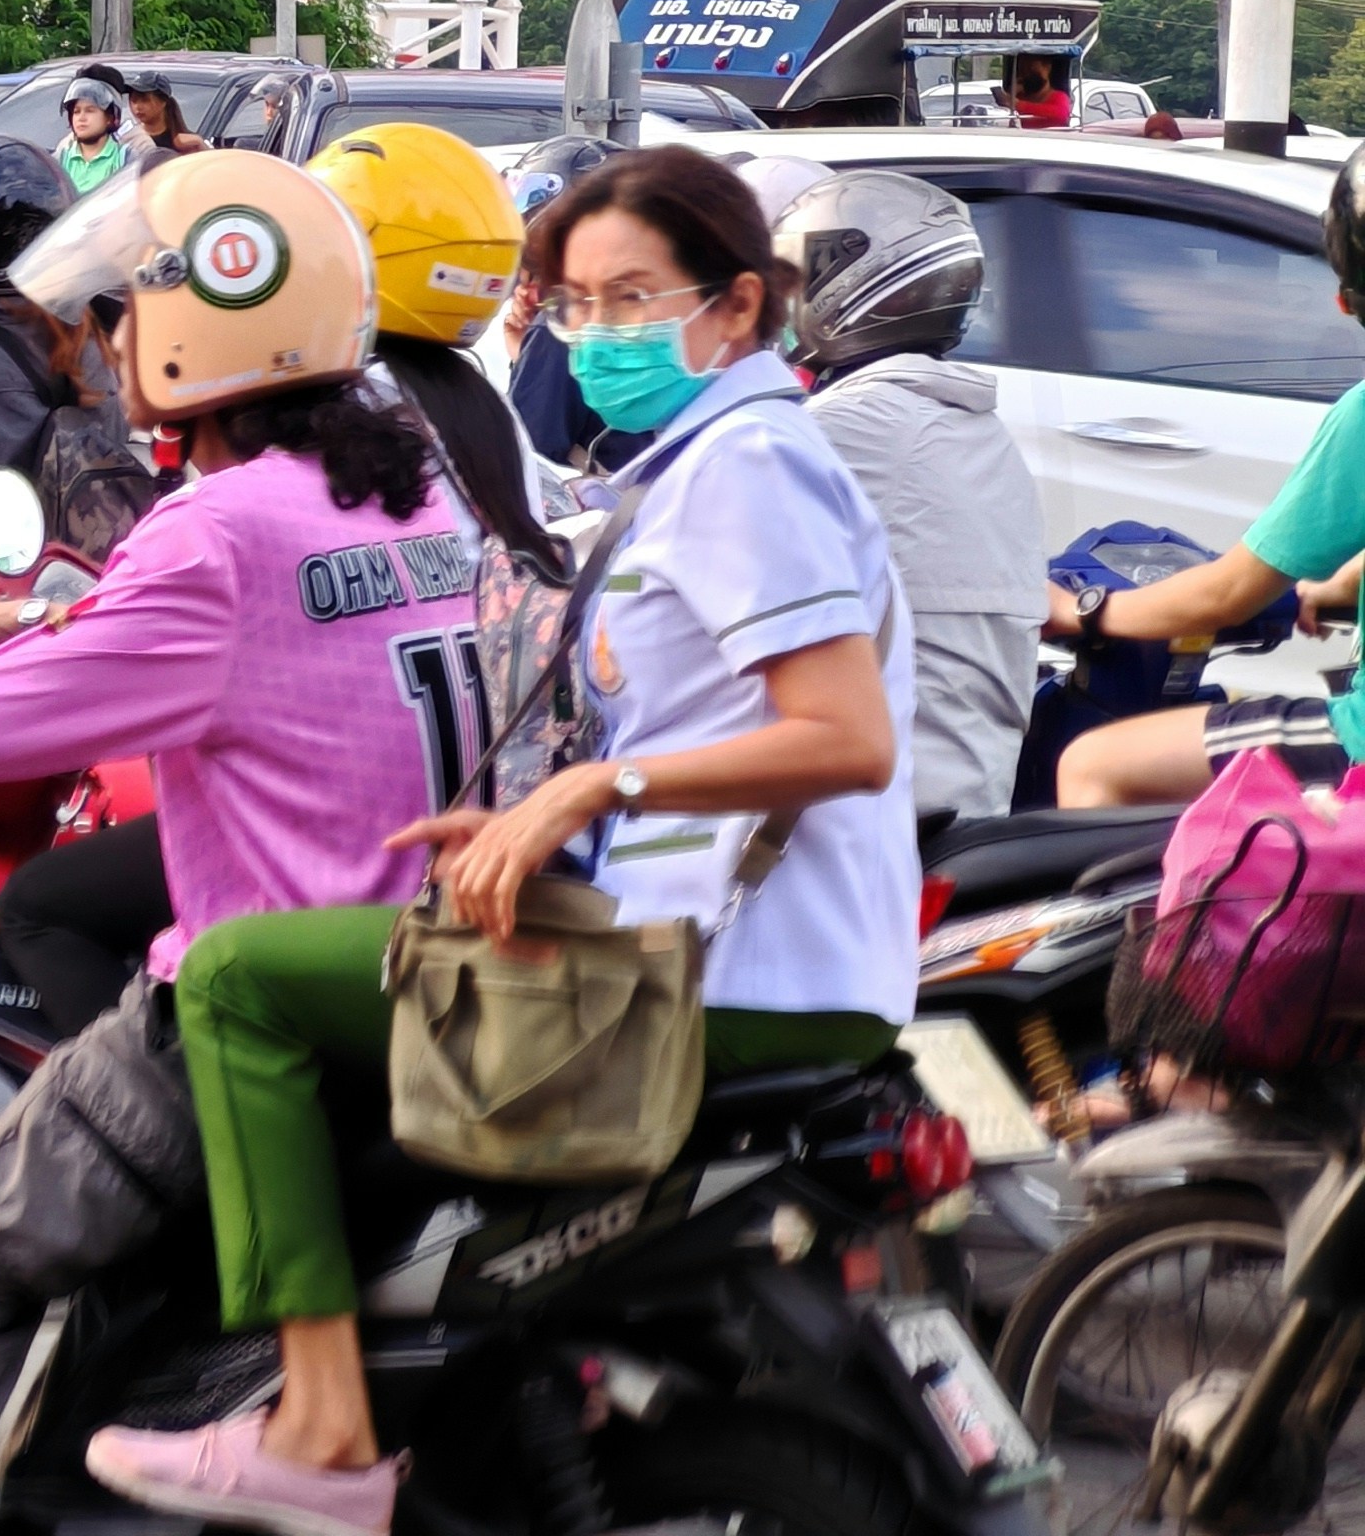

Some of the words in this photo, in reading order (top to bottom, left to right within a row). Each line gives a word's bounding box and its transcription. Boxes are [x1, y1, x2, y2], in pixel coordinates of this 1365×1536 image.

[650, 0, 691, 16] มอ.
[643, 19, 774, 48] นาม่วง
[297, 542, 407, 623] OHM
